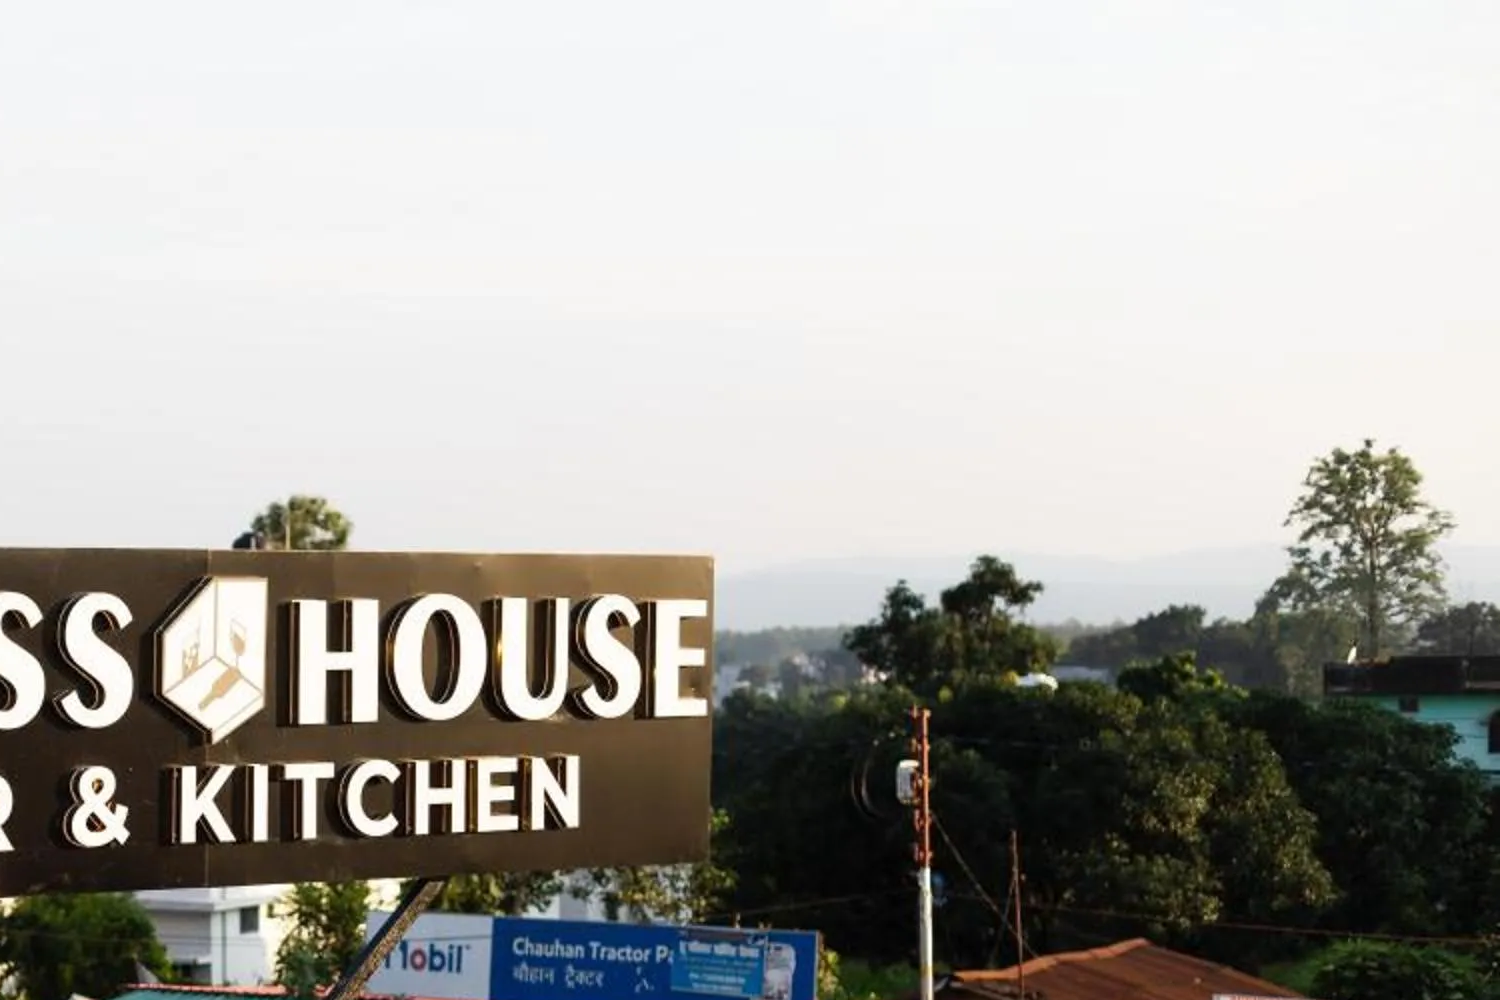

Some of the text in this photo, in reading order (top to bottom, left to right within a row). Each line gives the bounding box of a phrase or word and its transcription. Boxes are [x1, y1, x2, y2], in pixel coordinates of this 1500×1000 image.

[297, 592, 708, 725] HOUSE
[68, 765, 130, 848] &
[178, 755, 581, 844] KITCHEN
[512, 936, 585, 960] Chauhan
[589, 940, 652, 964] Tractor
